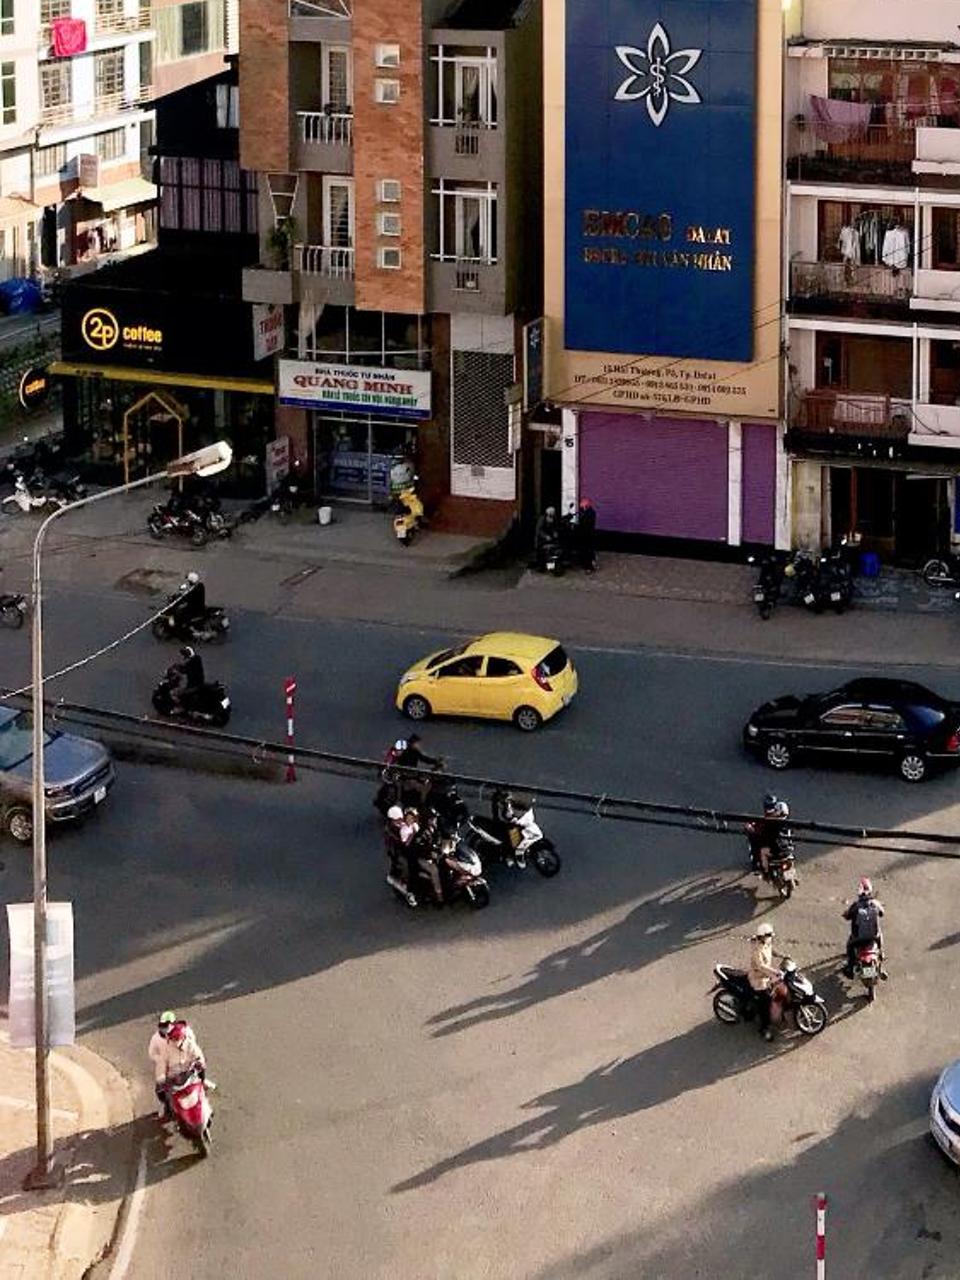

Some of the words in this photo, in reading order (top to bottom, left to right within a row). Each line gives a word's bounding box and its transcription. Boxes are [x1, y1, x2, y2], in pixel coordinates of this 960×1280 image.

[122, 326, 163, 344] coffee
[293, 375, 359, 391] QUANG
[364, 381, 414, 395] MINH
